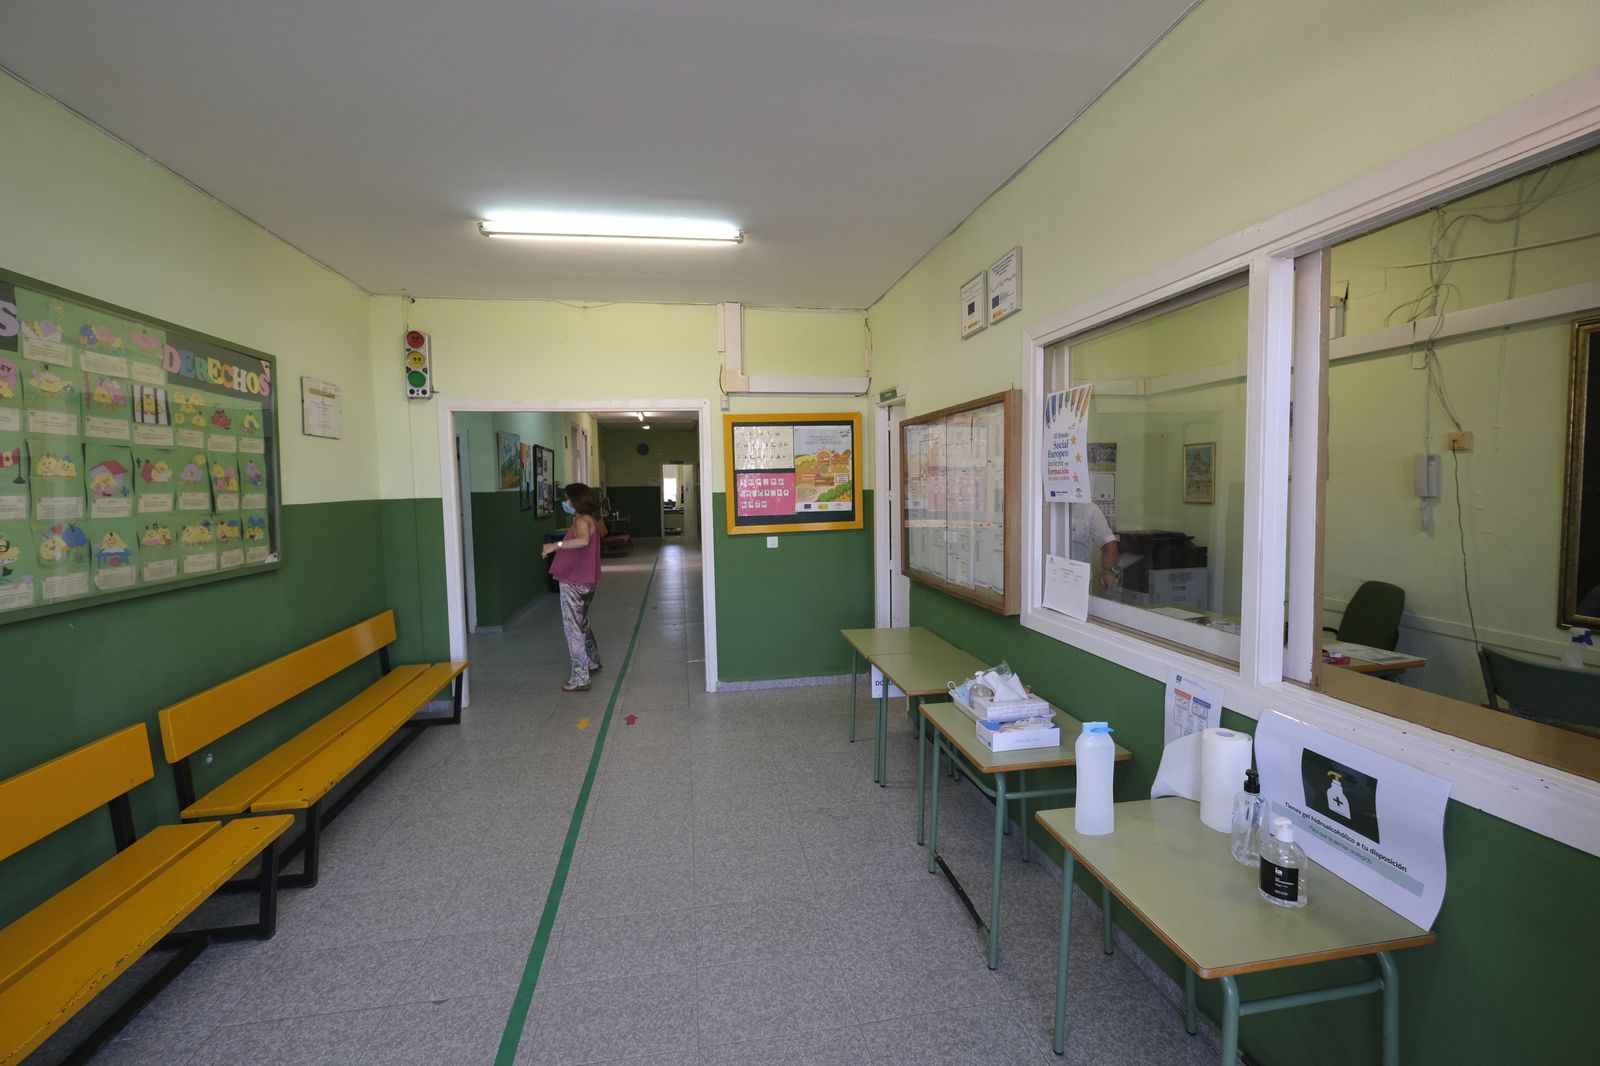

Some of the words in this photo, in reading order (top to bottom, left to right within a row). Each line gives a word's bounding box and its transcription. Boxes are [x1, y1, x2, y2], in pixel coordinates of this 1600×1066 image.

[163, 344, 271, 397] DERECHOS
[1048, 450, 1069, 459] Europeo
[1053, 439, 1069, 449] Social
[1284, 802, 1302, 816] Tienes
[1302, 811, 1311, 820] gel
[1311, 816, 1355, 844] hidroalcohólico
[1361, 843, 1369, 852] tu
[1369, 848, 1408, 872] disposición
